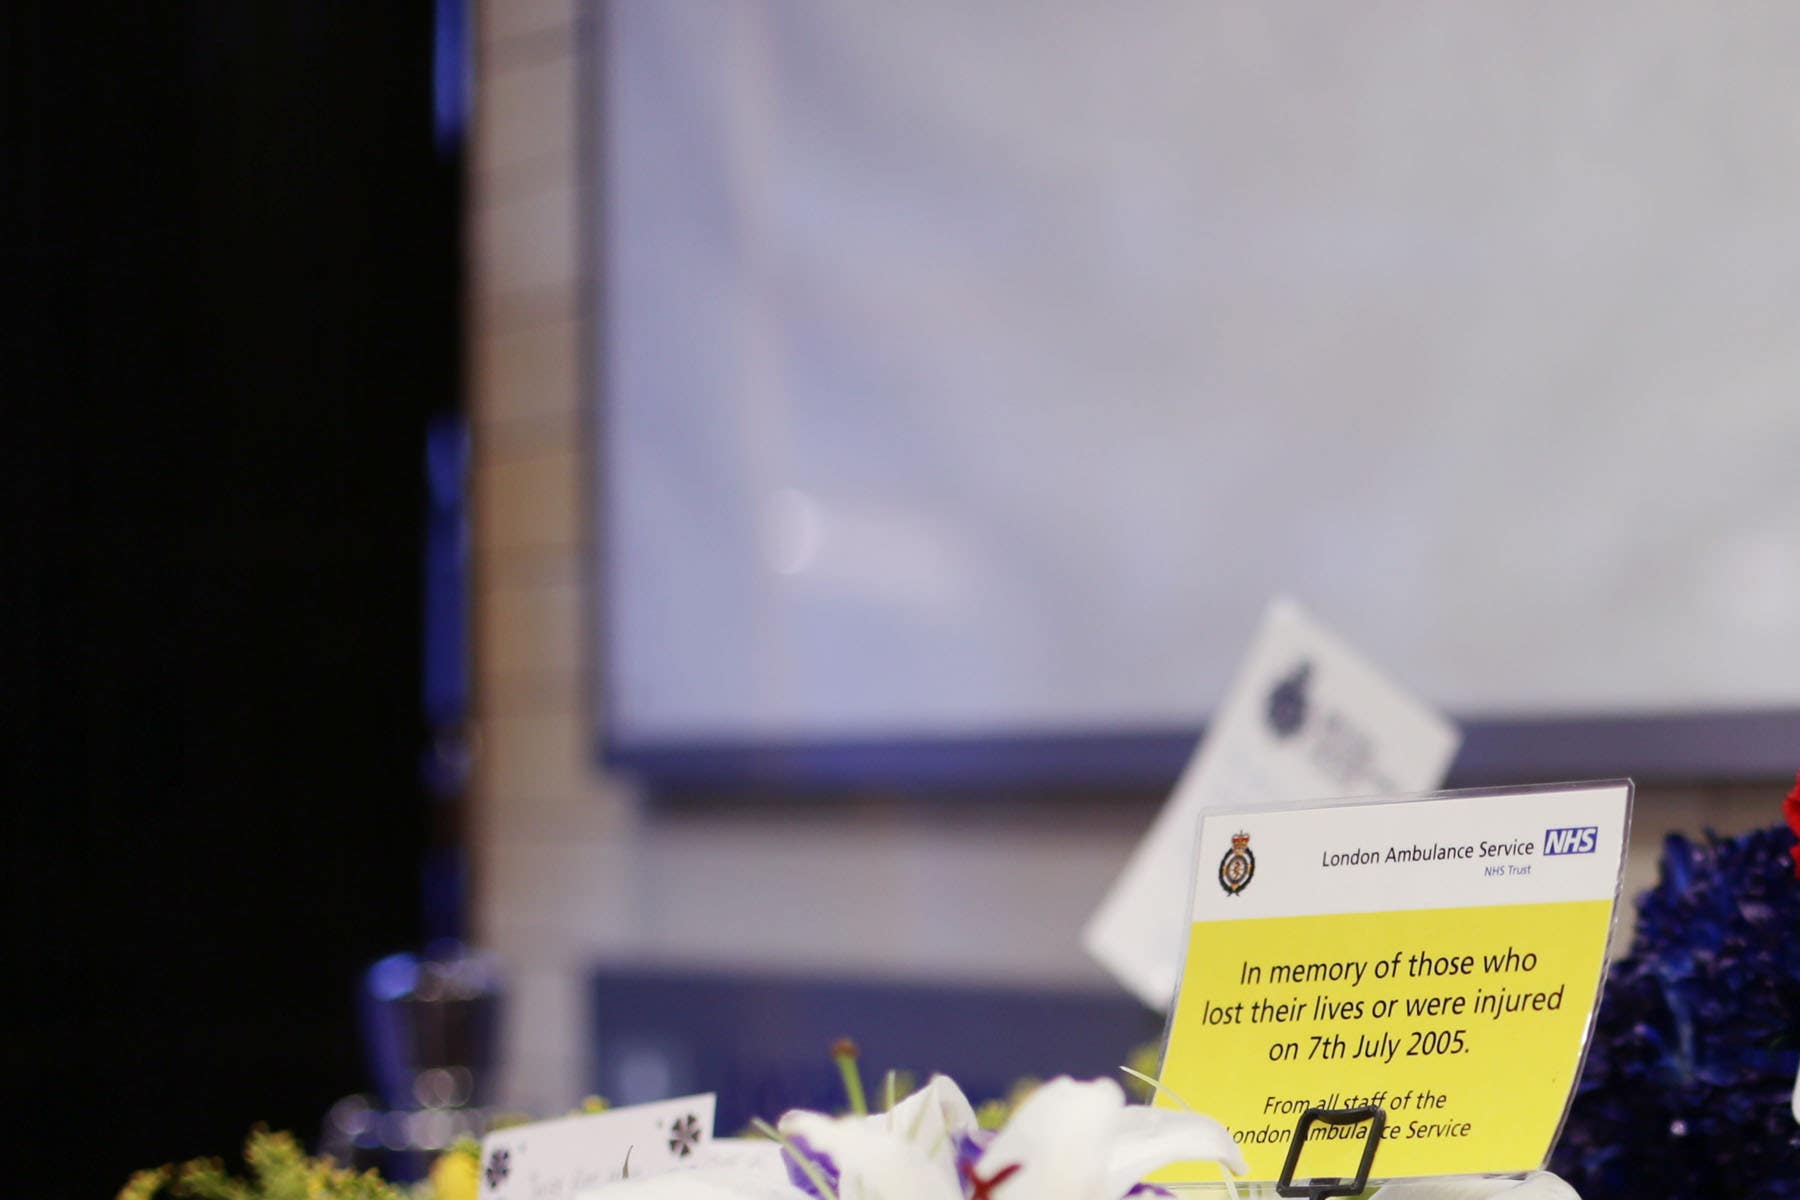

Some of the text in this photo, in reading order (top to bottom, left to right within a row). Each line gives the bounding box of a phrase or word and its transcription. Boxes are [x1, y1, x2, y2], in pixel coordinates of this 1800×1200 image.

[1322, 839, 1535, 867] London Ambulance Service
[1545, 828, 1597, 854] NHS
[1484, 864, 1532, 877] NHS Trust
[1240, 946, 1538, 987] In memory of those who
[1202, 984, 1565, 1026] lost their lives or were injured
[1268, 1030, 1471, 1064] on 7th July 2005.
[1263, 1089, 1447, 1114] From all staff of the
[1226, 1118, 1472, 1144] ondon mbulace Service
